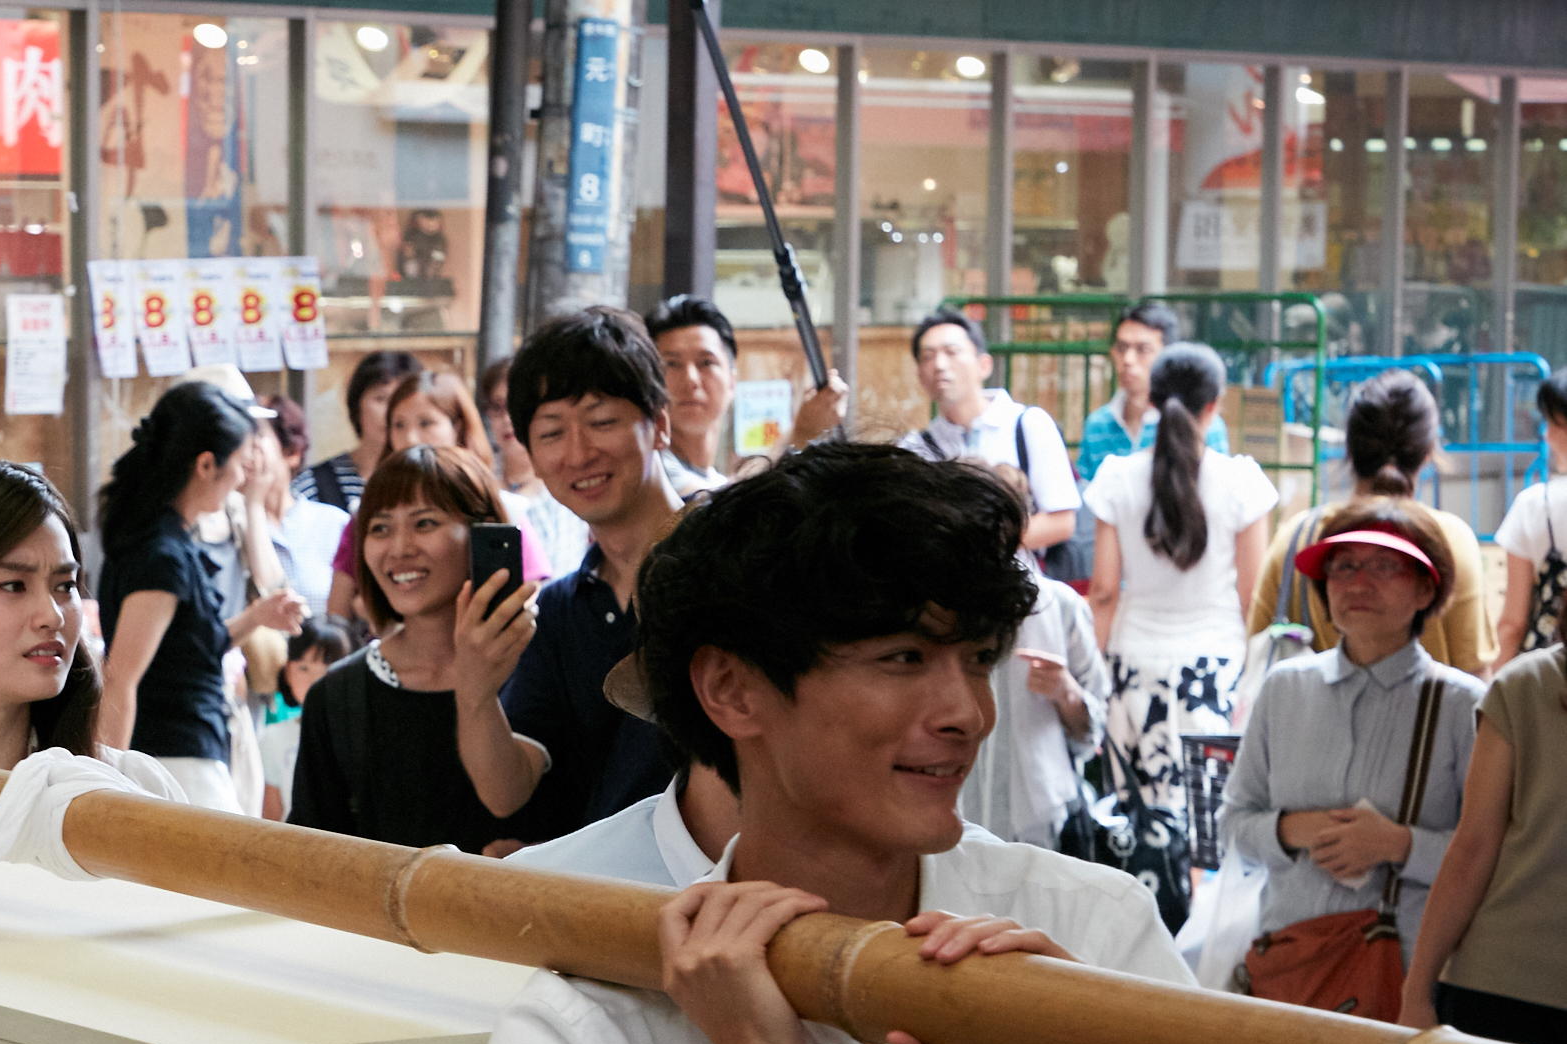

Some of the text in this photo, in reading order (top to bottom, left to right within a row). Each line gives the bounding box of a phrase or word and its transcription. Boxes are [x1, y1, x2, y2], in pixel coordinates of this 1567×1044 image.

[579, 172, 600, 202] 8
[145, 296, 165, 328] 8
[194, 294, 214, 326] 8
[242, 293, 262, 324] 8
[293, 291, 317, 322] 8
